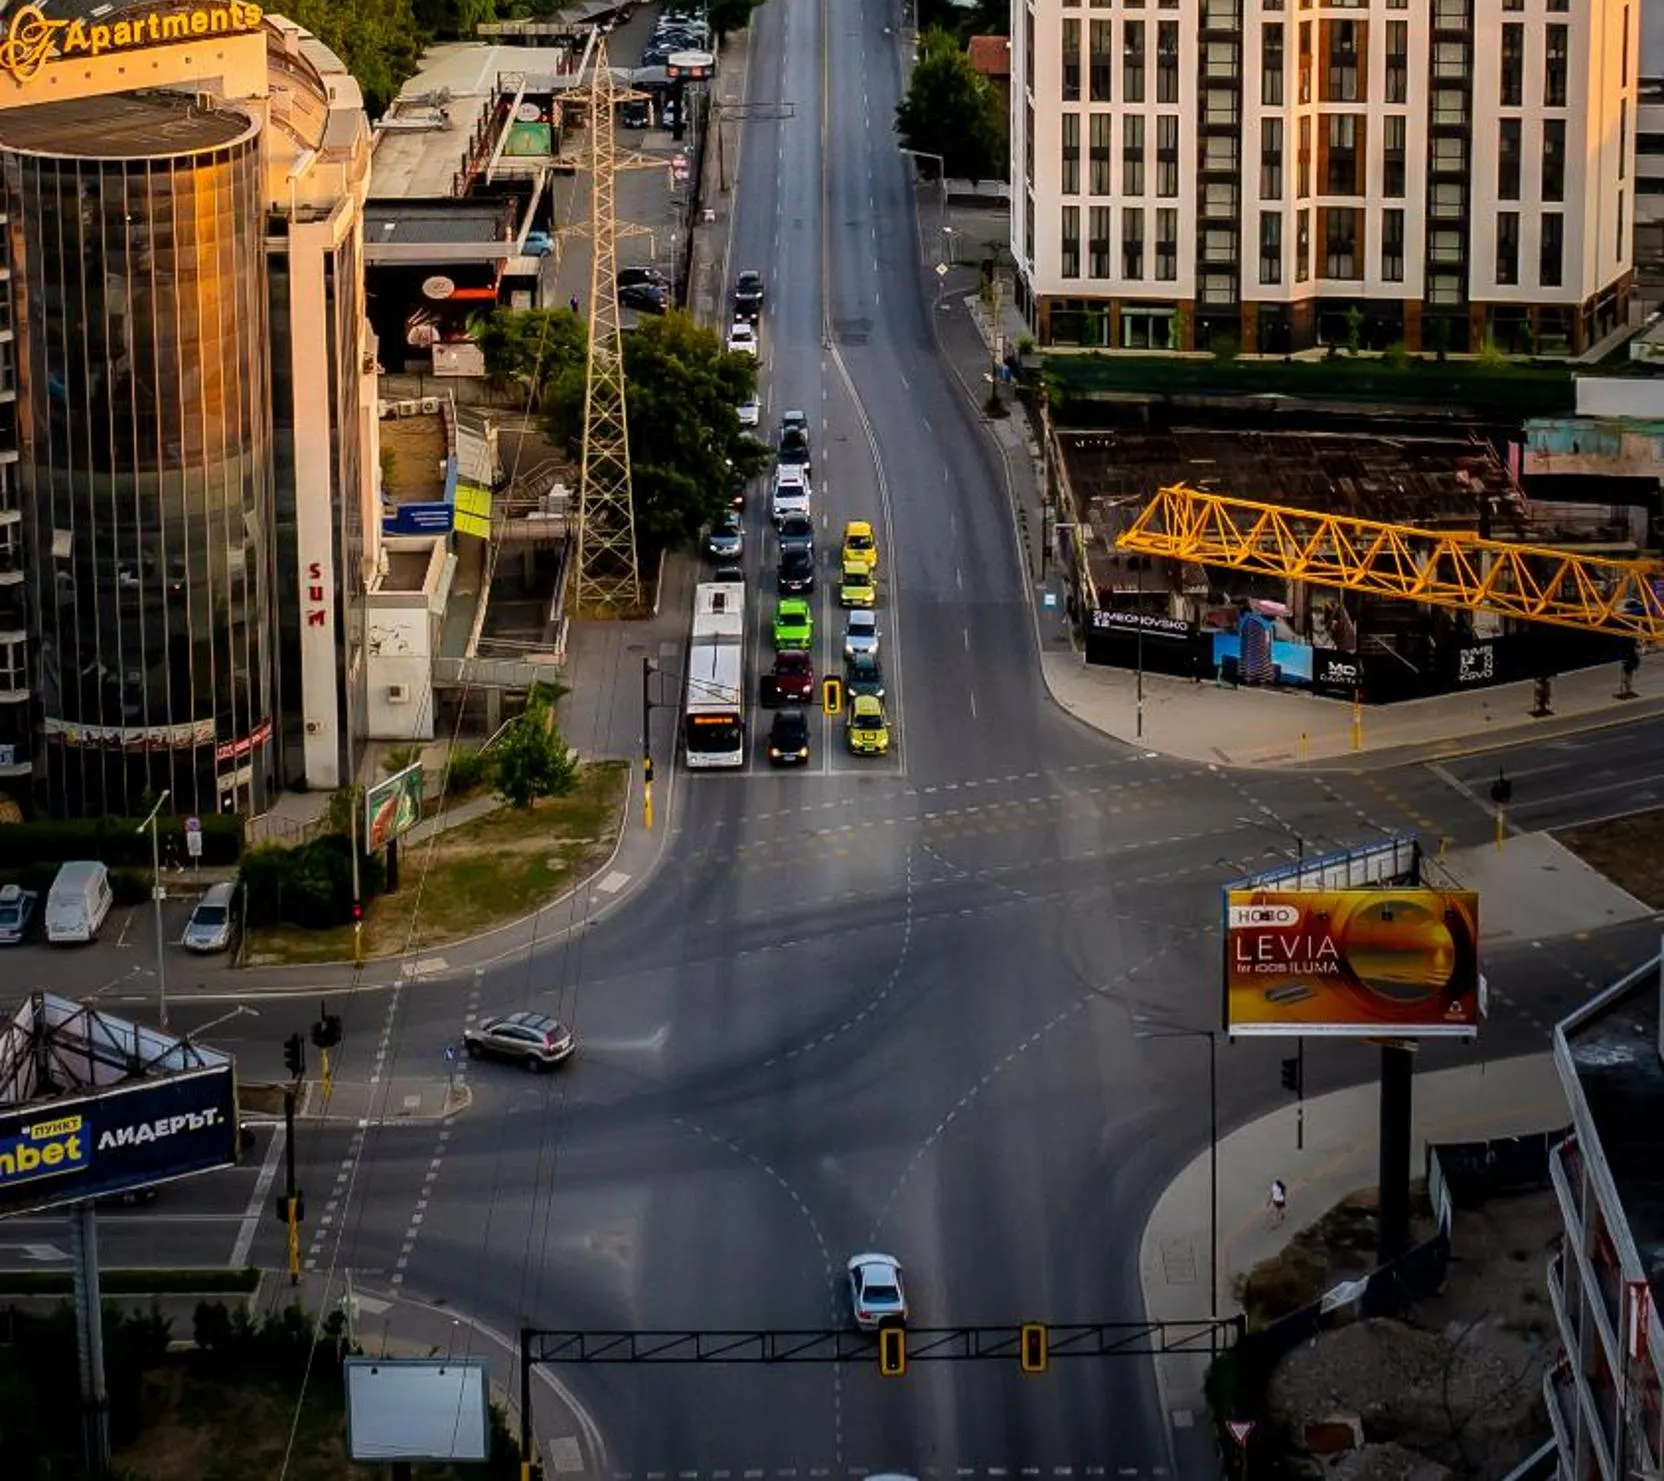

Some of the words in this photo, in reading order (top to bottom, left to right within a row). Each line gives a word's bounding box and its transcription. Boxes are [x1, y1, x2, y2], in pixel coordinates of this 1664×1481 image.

[63, 1, 264, 55] Apartments
[308, 562, 326, 627] SUM
[1237, 935, 1339, 961] LEVIA
[98, 1107, 225, 1150] ЛИДЕРЪТ.
